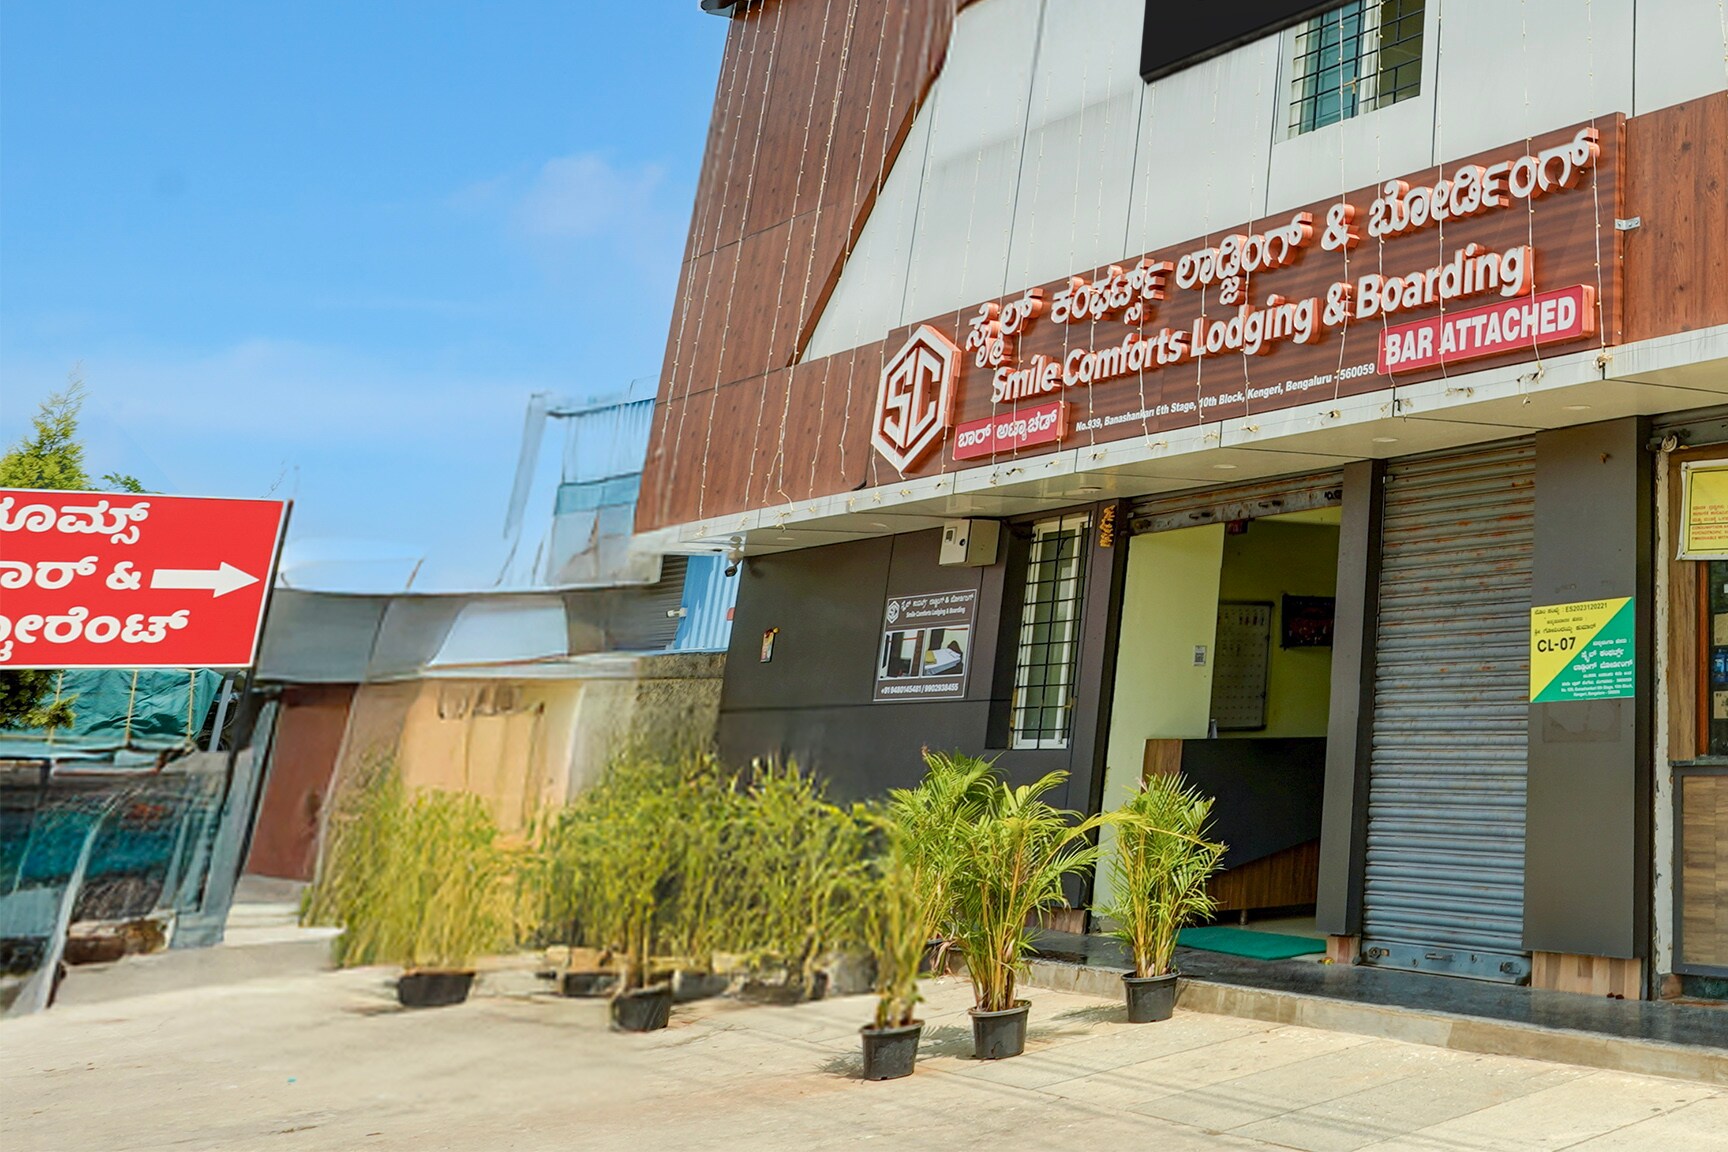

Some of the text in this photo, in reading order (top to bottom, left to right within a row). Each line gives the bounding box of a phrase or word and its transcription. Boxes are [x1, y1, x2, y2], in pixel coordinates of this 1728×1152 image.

[1321, 203, 1354, 251] &
[991, 242, 1533, 404] Smile Comforts Lodging & Boarding
[1385, 296, 1577, 366] BAR ATTACHED
[1170, 400, 1197, 415] Stage,
[1219, 389, 1245, 406] Block,
[1247, 382, 1284, 401] Kengeri,
[1286, 373, 1332, 394] Bengaluru
[1340, 363, 1376, 381] 560059
[105, 561, 143, 590] &
[1537, 637, 1576, 652] CL-07
